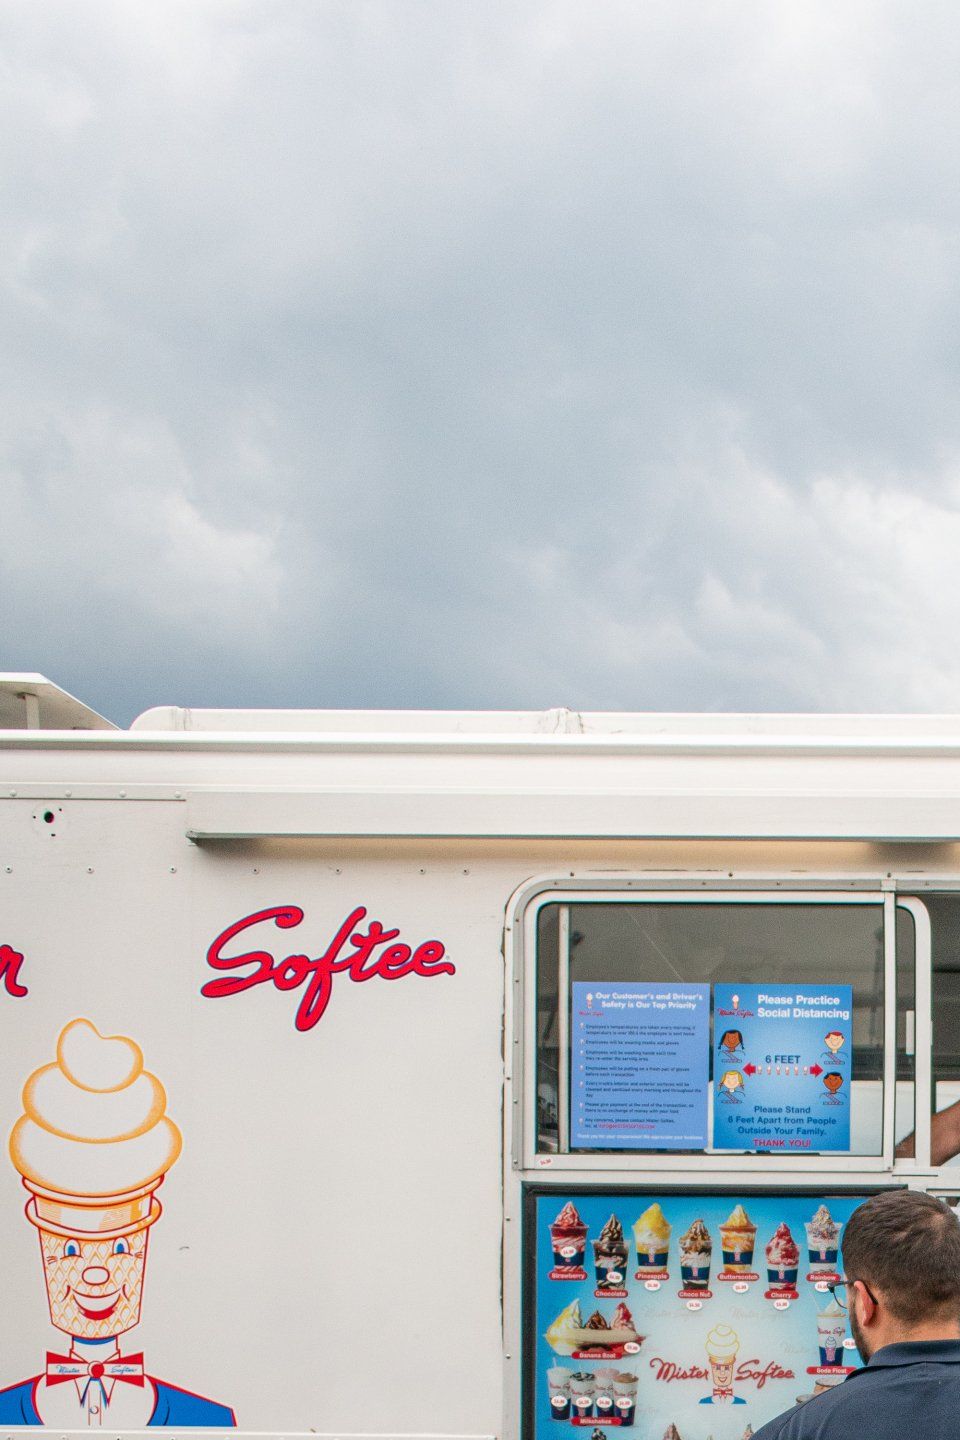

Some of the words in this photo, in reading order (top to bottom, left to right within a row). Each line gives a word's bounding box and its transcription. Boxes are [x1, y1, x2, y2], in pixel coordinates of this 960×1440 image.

[200, 905, 456, 1031] Softee
[595, 992, 610, 1000] Our
[612, 992, 654, 1000] Customer's
[656, 992, 670, 1000] and
[672, 992, 703, 1000] Driver's
[757, 994, 792, 1005] Please
[796, 995, 840, 1005] Practice
[601, 1001, 626, 1010] Safety
[652, 1002, 667, 1010] Top
[668, 1002, 696, 1010] Priority
[757, 1007, 790, 1018] Social
[793, 1008, 850, 1020] Distancing
[765, 1055, 772, 1064] 6
[774, 1055, 801, 1064] FEET
[756, 1116, 781, 1126] Apart
[783, 1116, 804, 1124] from
[806, 1117, 837, 1126] People
[737, 1126, 771, 1134] Outside
[774, 1126, 794, 1134] Your
[796, 1127, 827, 1136] Family.
[753, 1139, 785, 1147] THANK
[789, 1139, 811, 1147] YOU!
[551, 1272, 585, 1280] Strawberry
[650, 1358, 709, 1383] Mister
[735, 1359, 795, 1389] Softee
